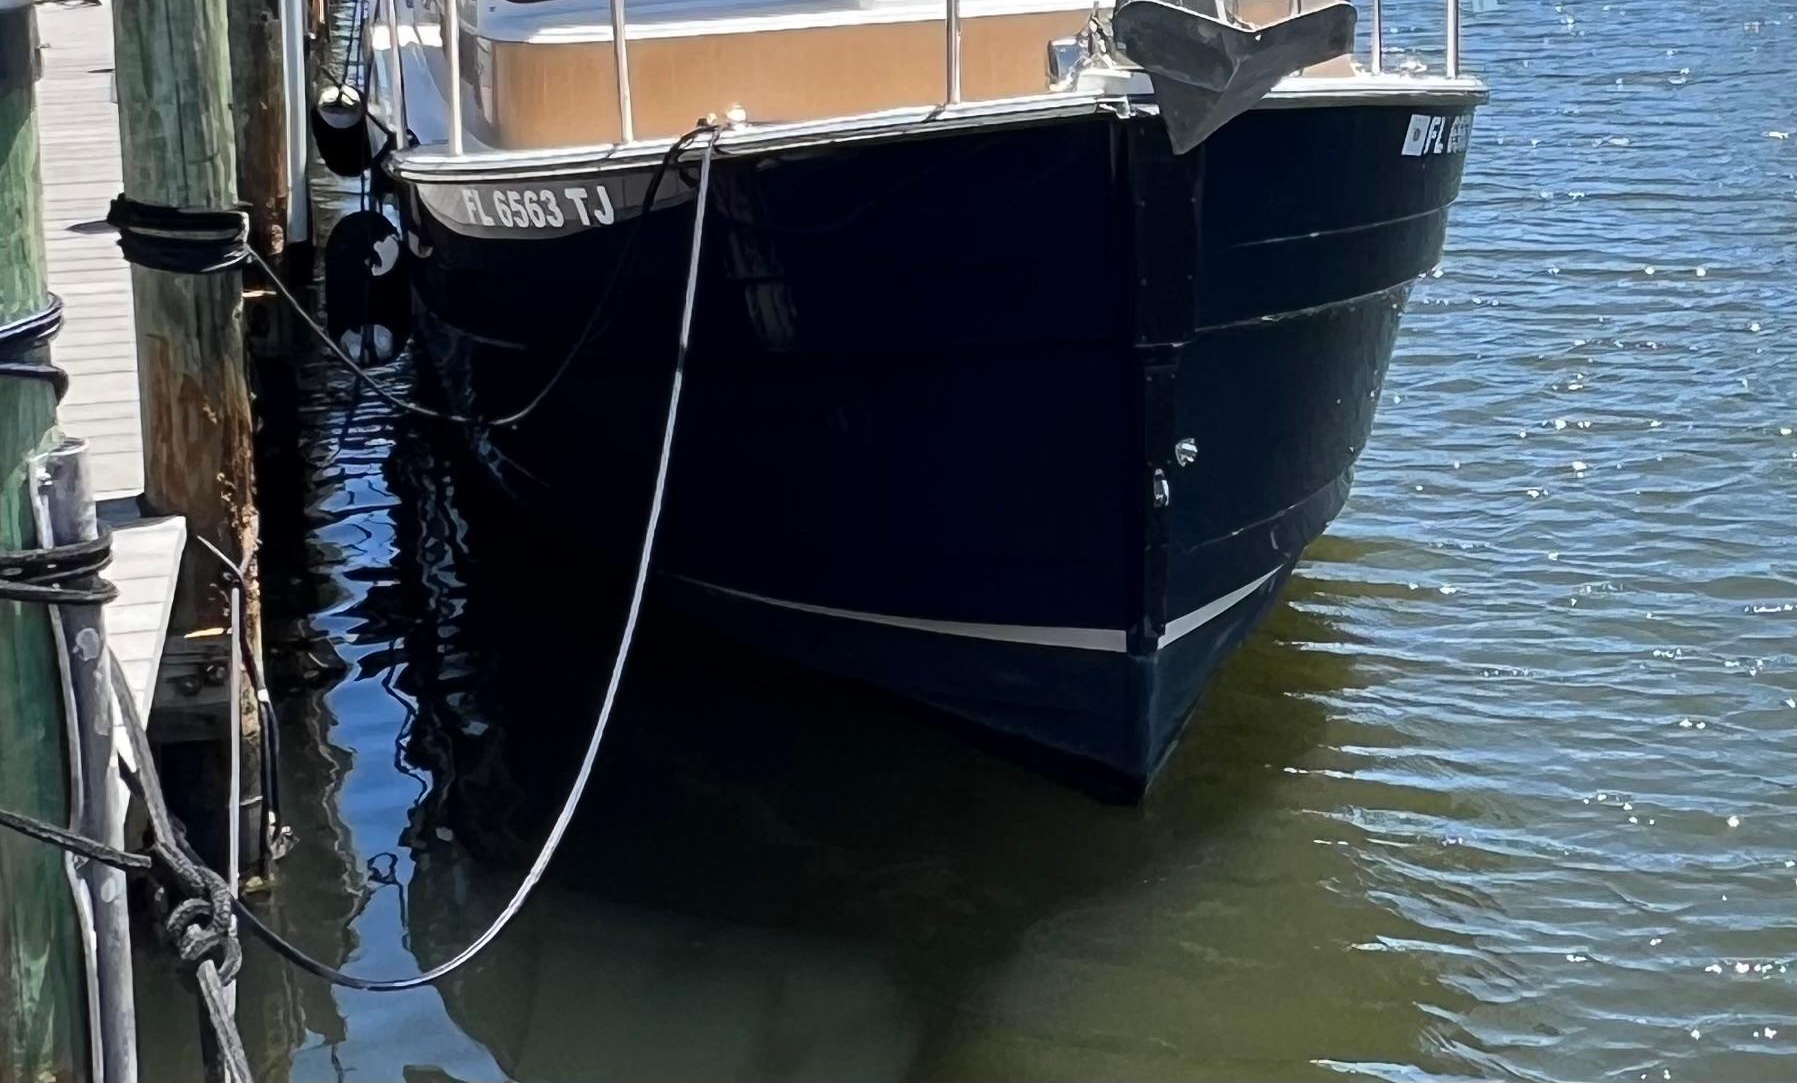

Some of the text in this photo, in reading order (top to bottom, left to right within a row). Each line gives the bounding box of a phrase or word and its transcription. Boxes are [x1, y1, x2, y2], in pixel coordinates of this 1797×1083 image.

[461, 185, 615, 228] FL 6563 TJ
